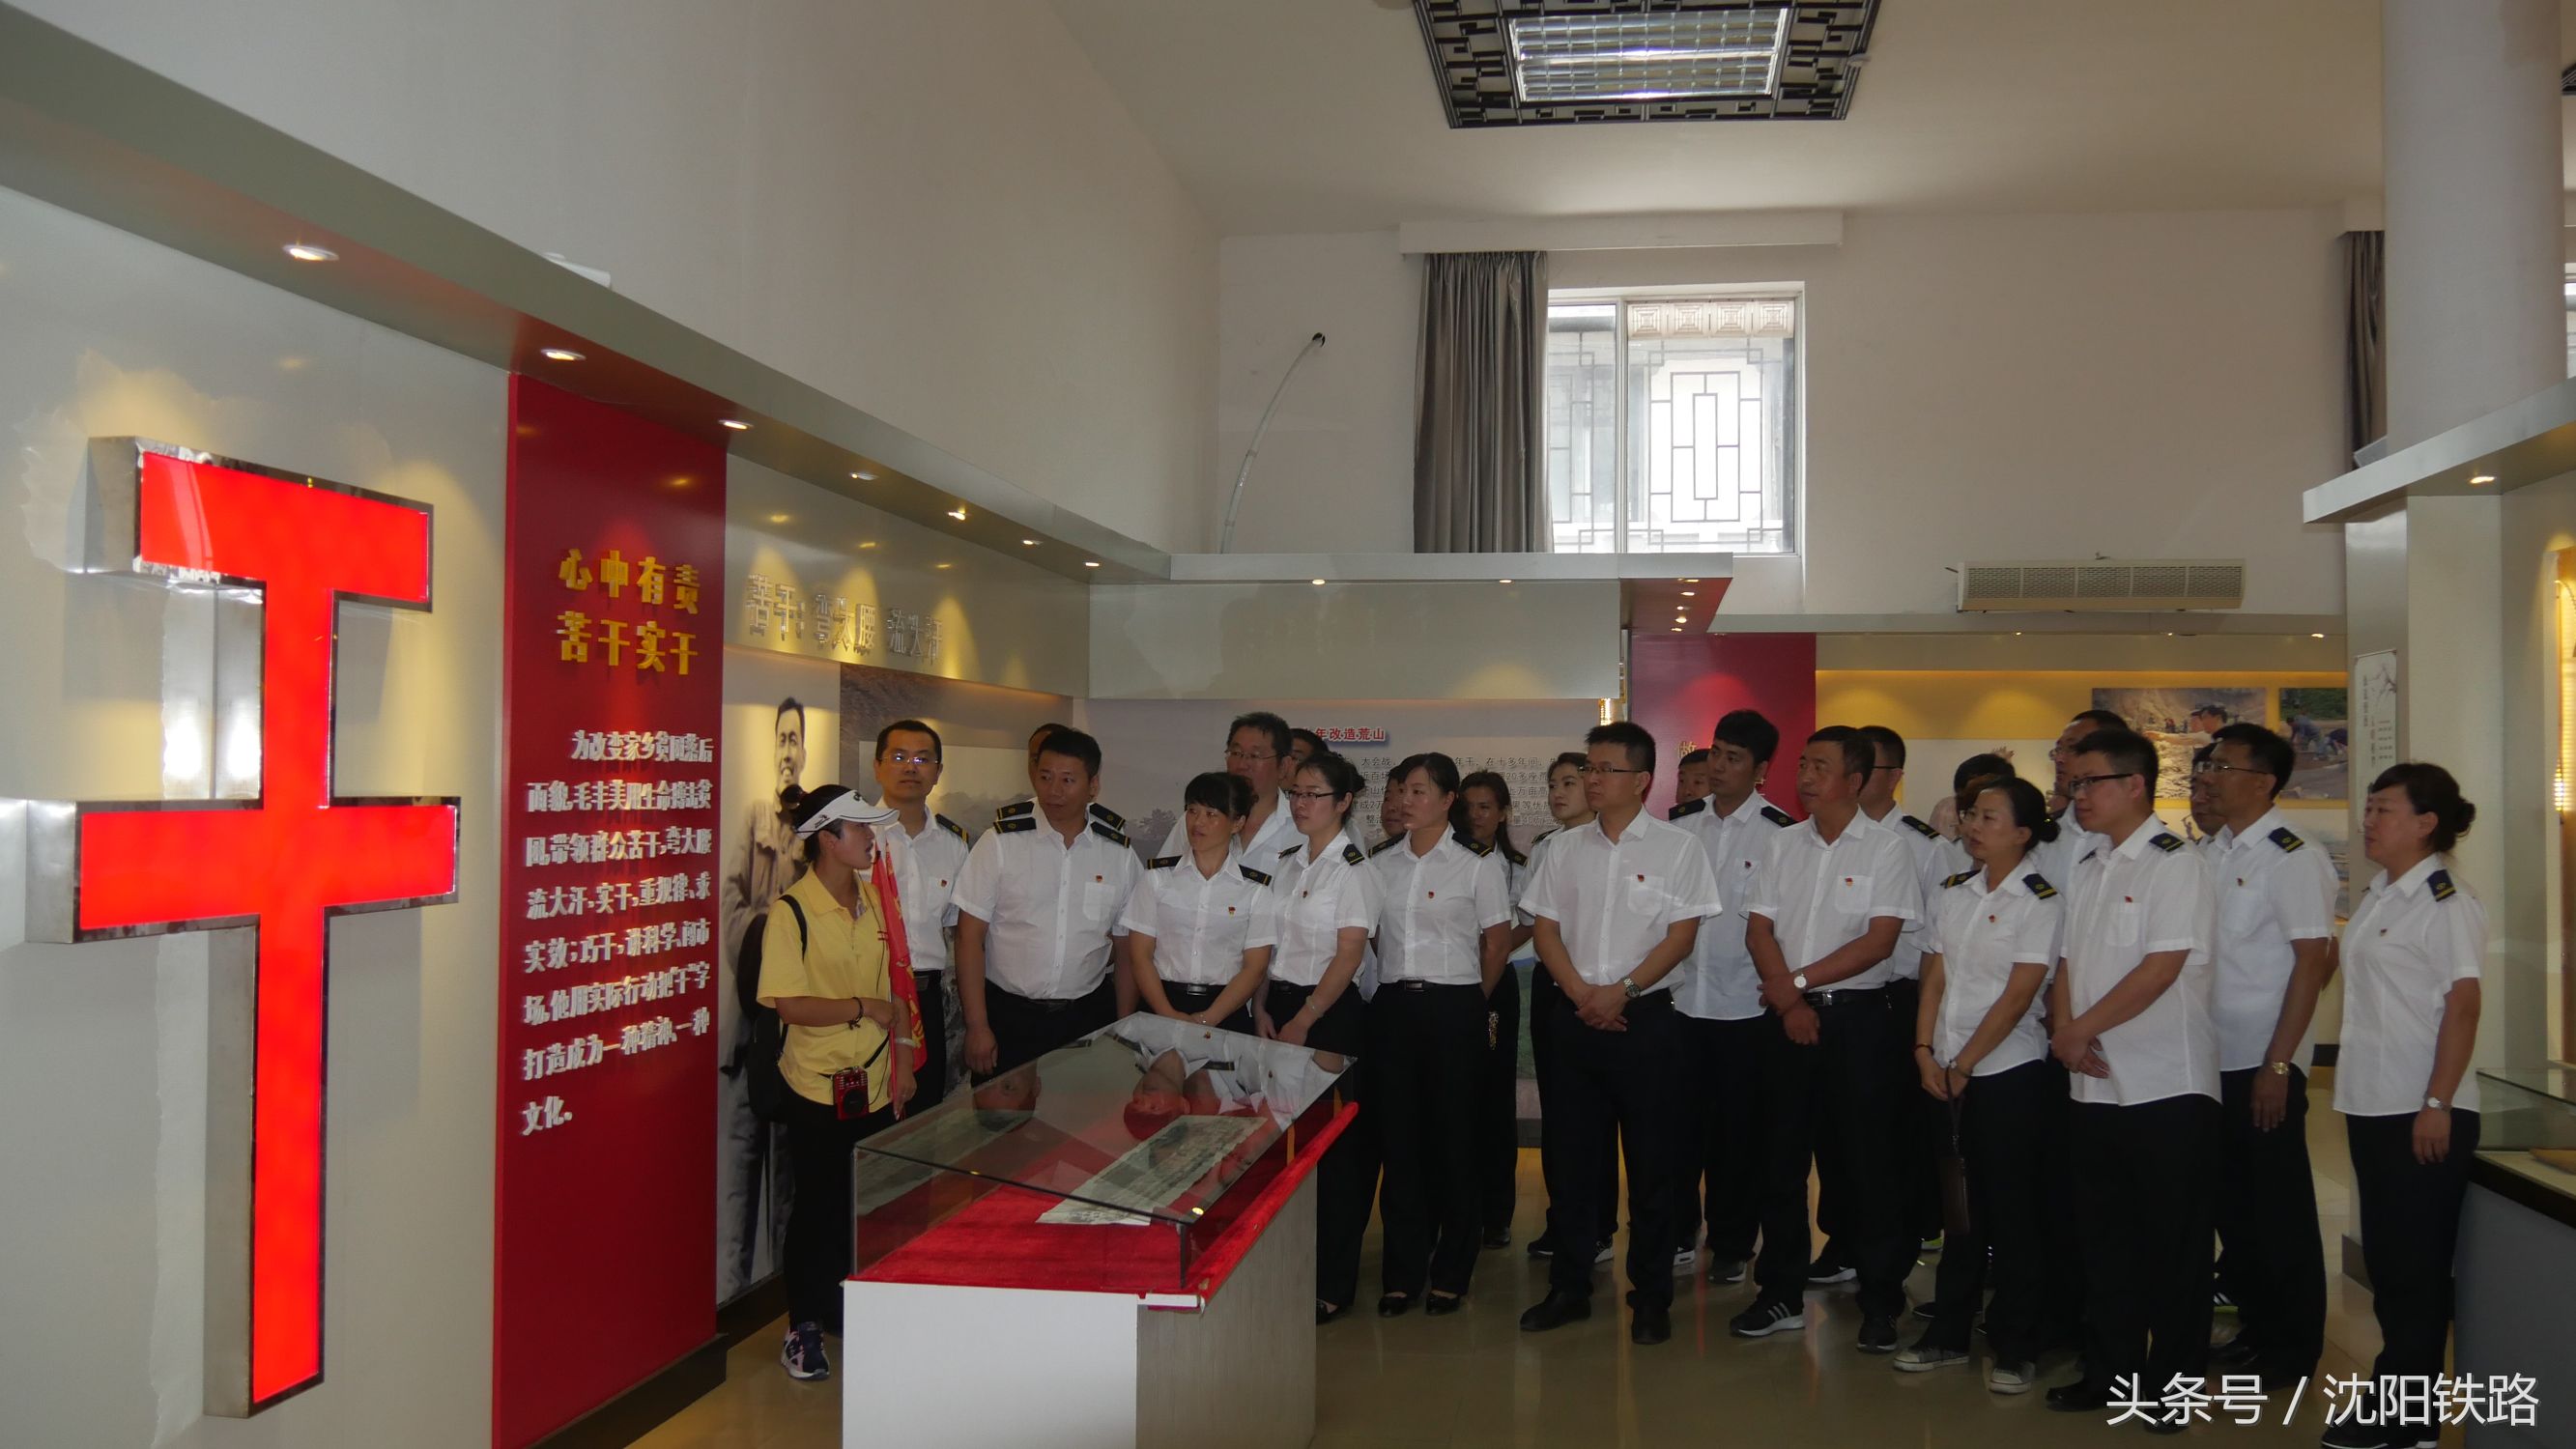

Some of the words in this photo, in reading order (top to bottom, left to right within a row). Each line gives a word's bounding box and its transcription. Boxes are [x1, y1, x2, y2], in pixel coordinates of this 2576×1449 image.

[558, 548, 701, 615] 心中有责
[557, 611, 699, 675] 苦干实干
[887, 607, 943, 666] 流大汗
[571, 729, 714, 763] 为改变家乡贫困落后
[1304, 726, 1386, 742] 年改造荒山
[68, 437, 460, 1418] 干
[522, 1094, 573, 1137] 文化。
